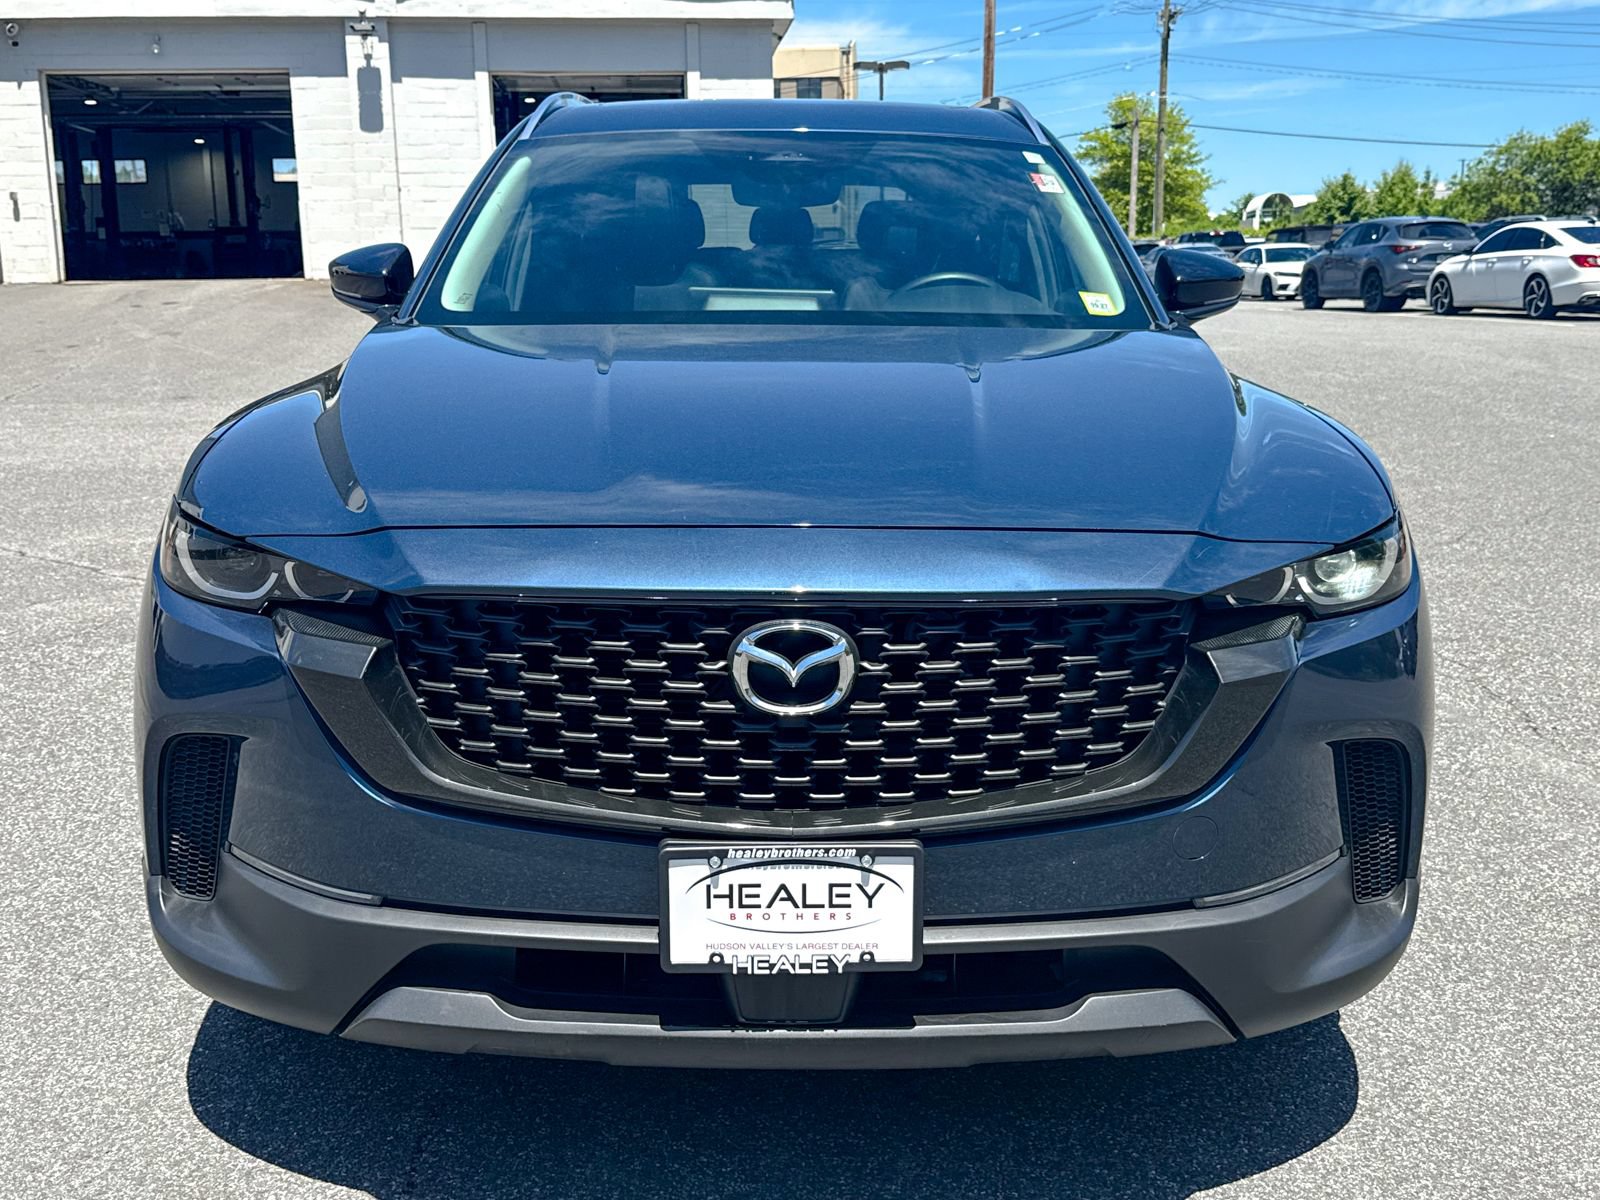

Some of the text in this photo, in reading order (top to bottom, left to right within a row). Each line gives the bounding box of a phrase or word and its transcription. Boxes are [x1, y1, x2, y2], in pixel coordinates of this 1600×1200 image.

[727, 848, 857, 859] healeybrothers.com
[706, 883, 885, 910] HEALEY
[729, 912, 852, 921] BROTHERS
[731, 954, 851, 975] HEALEY
